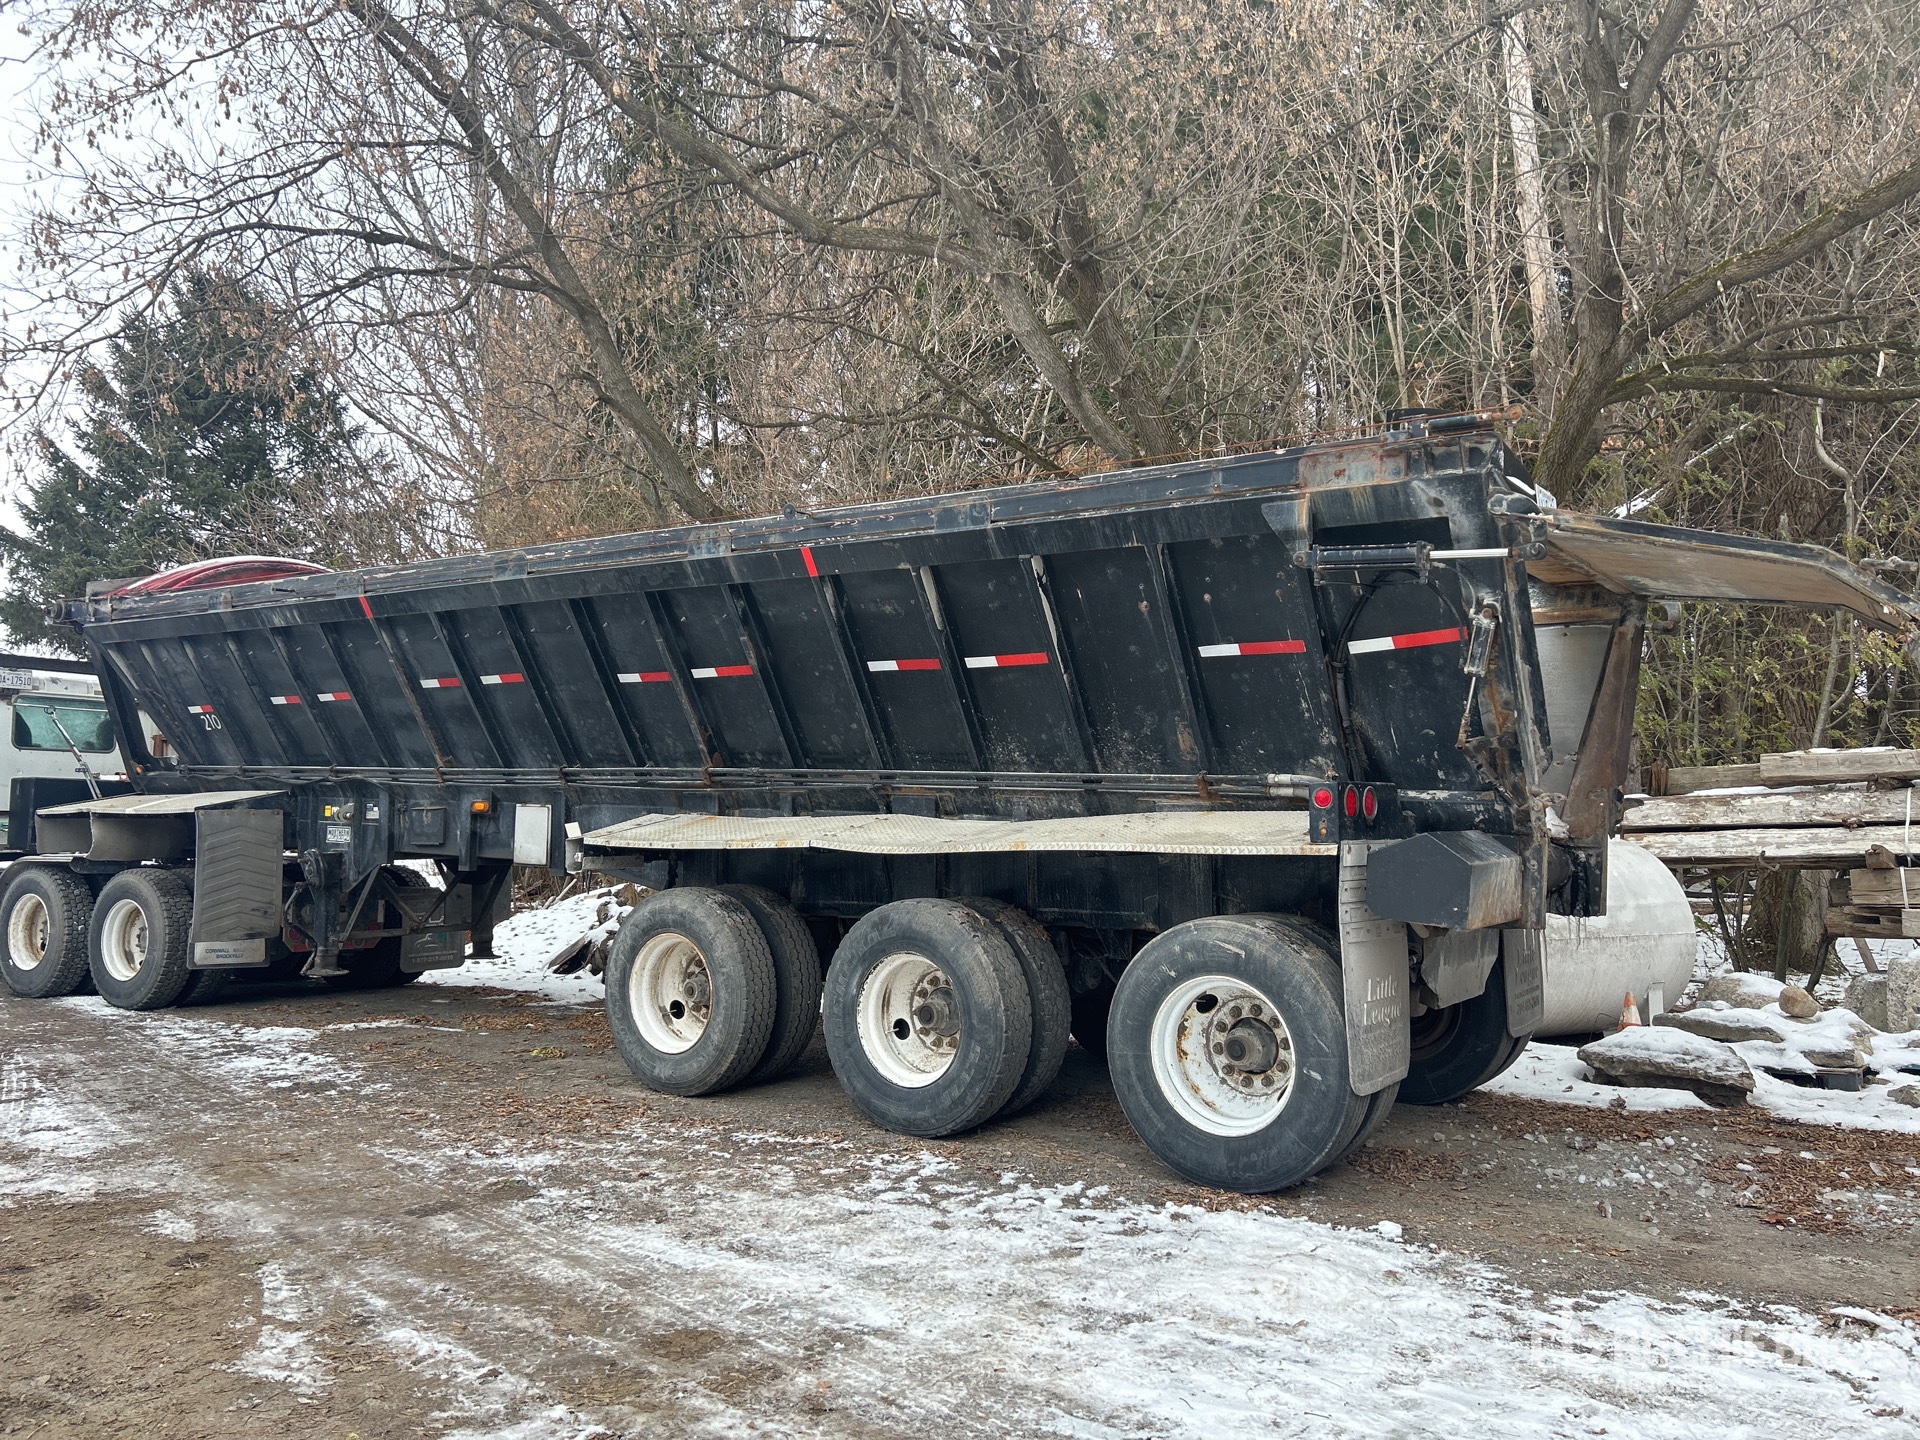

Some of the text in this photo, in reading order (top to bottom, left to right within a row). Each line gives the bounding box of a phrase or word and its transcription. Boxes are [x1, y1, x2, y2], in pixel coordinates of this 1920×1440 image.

[200, 713, 222, 731] 210
[1365, 974, 1398, 1003] Little
[1361, 1001, 1402, 1027] League
